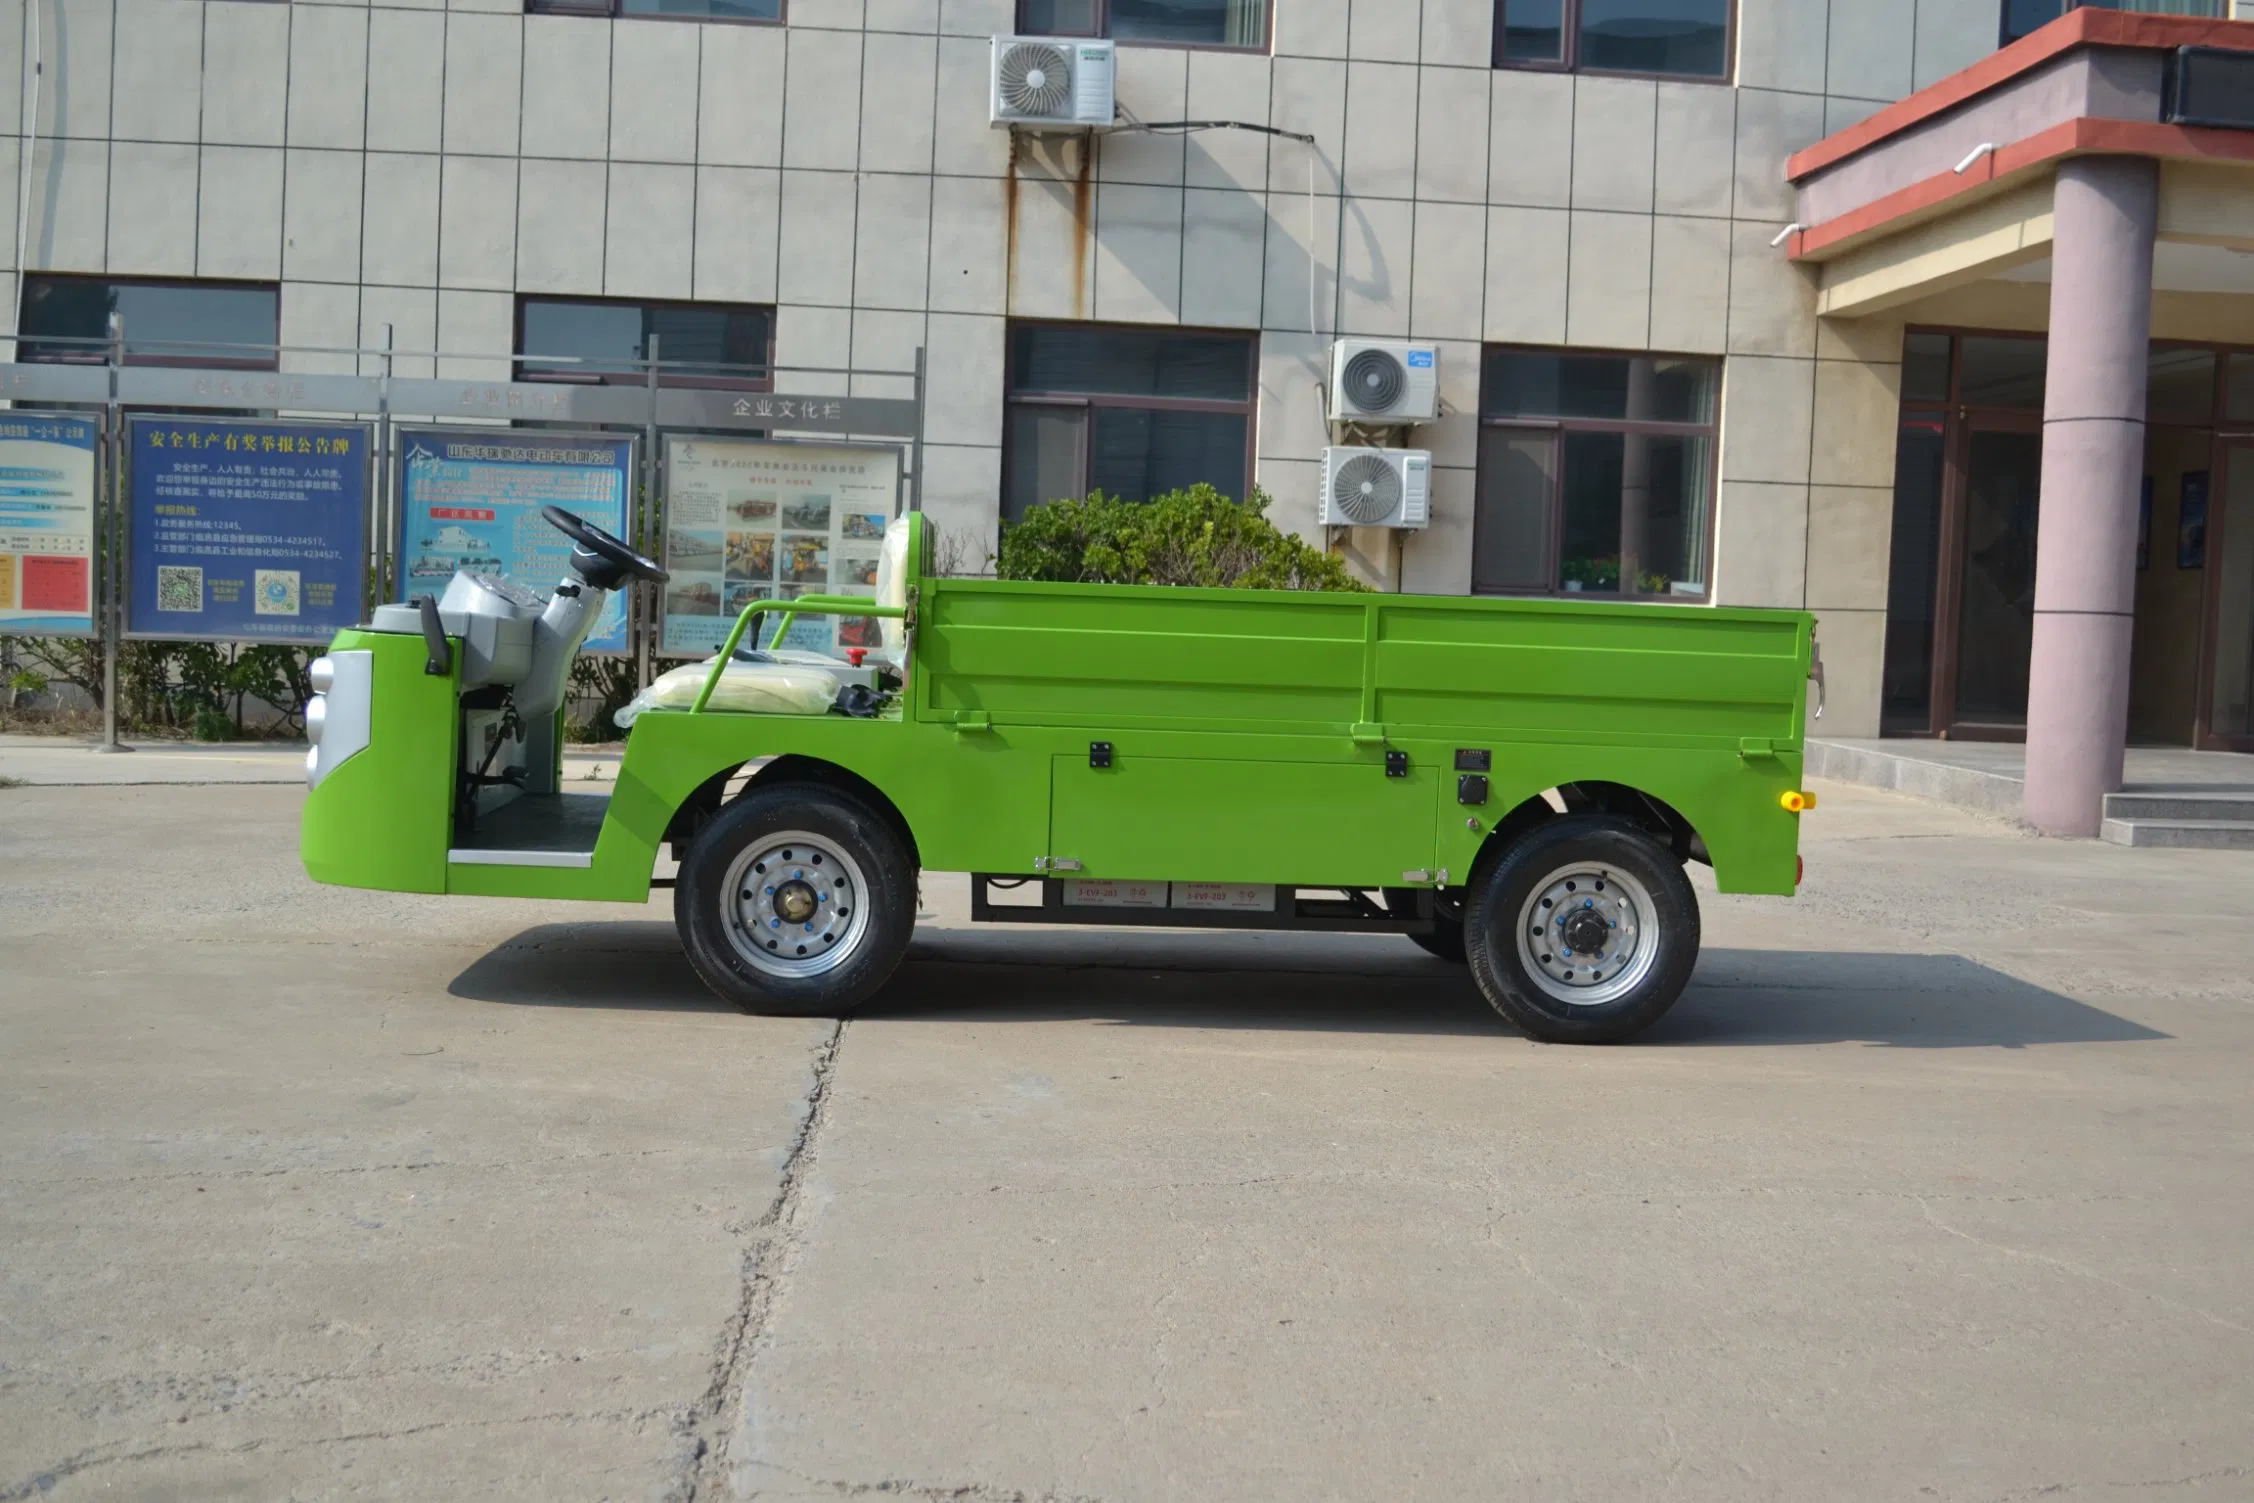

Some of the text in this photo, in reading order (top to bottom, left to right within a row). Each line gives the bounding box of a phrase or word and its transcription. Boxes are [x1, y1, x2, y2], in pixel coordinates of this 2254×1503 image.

[733, 398, 842, 420] 企业文化栏
[149, 431, 350, 455] 安全生产有奖举报公告牌
